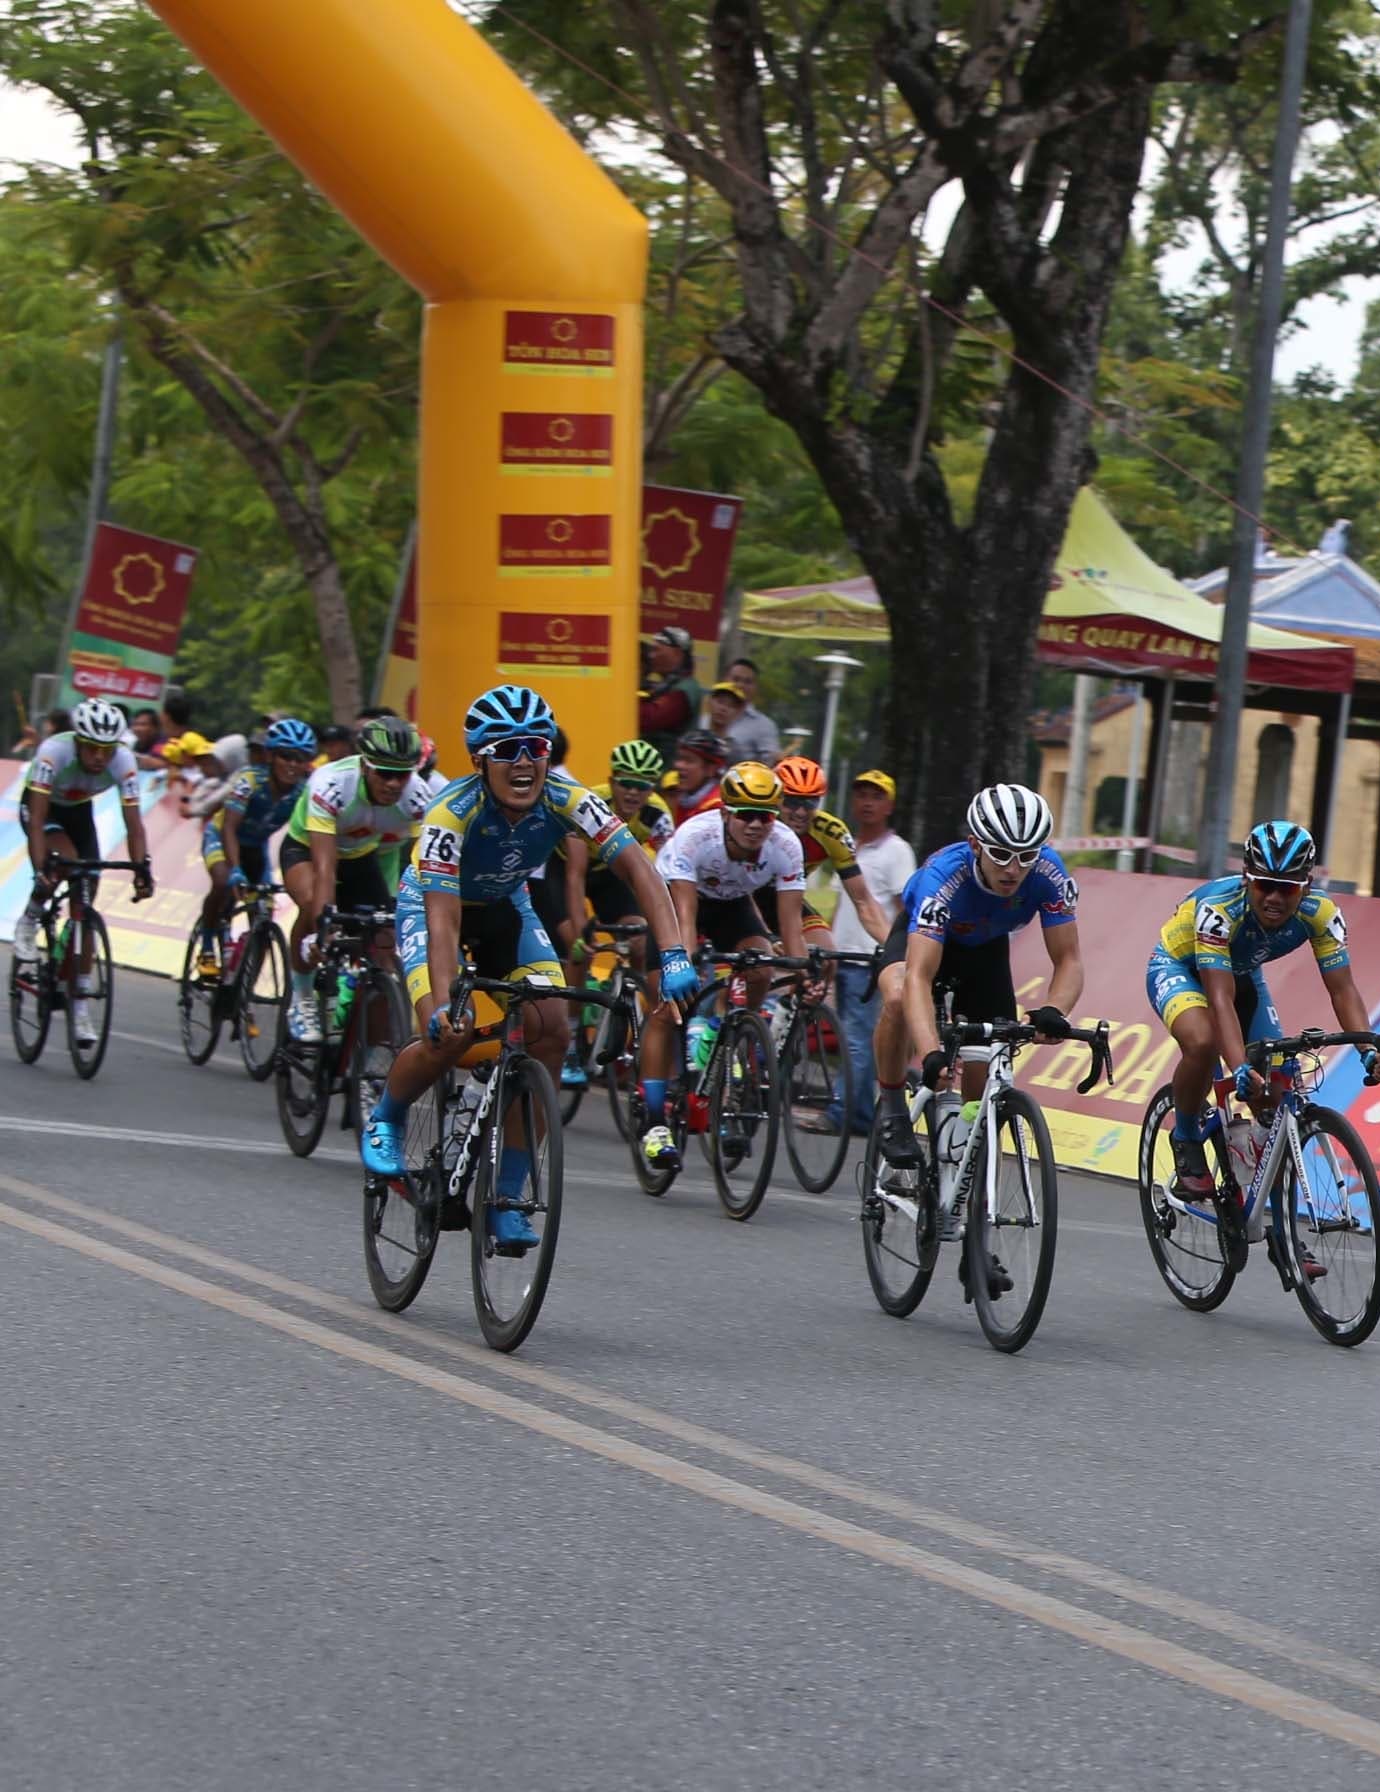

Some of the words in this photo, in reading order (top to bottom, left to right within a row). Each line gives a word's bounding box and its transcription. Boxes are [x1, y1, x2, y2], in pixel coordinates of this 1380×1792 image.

[424, 827, 456, 862] 76
[1201, 906, 1225, 937] 72
[663, 958, 690, 974] pgn
